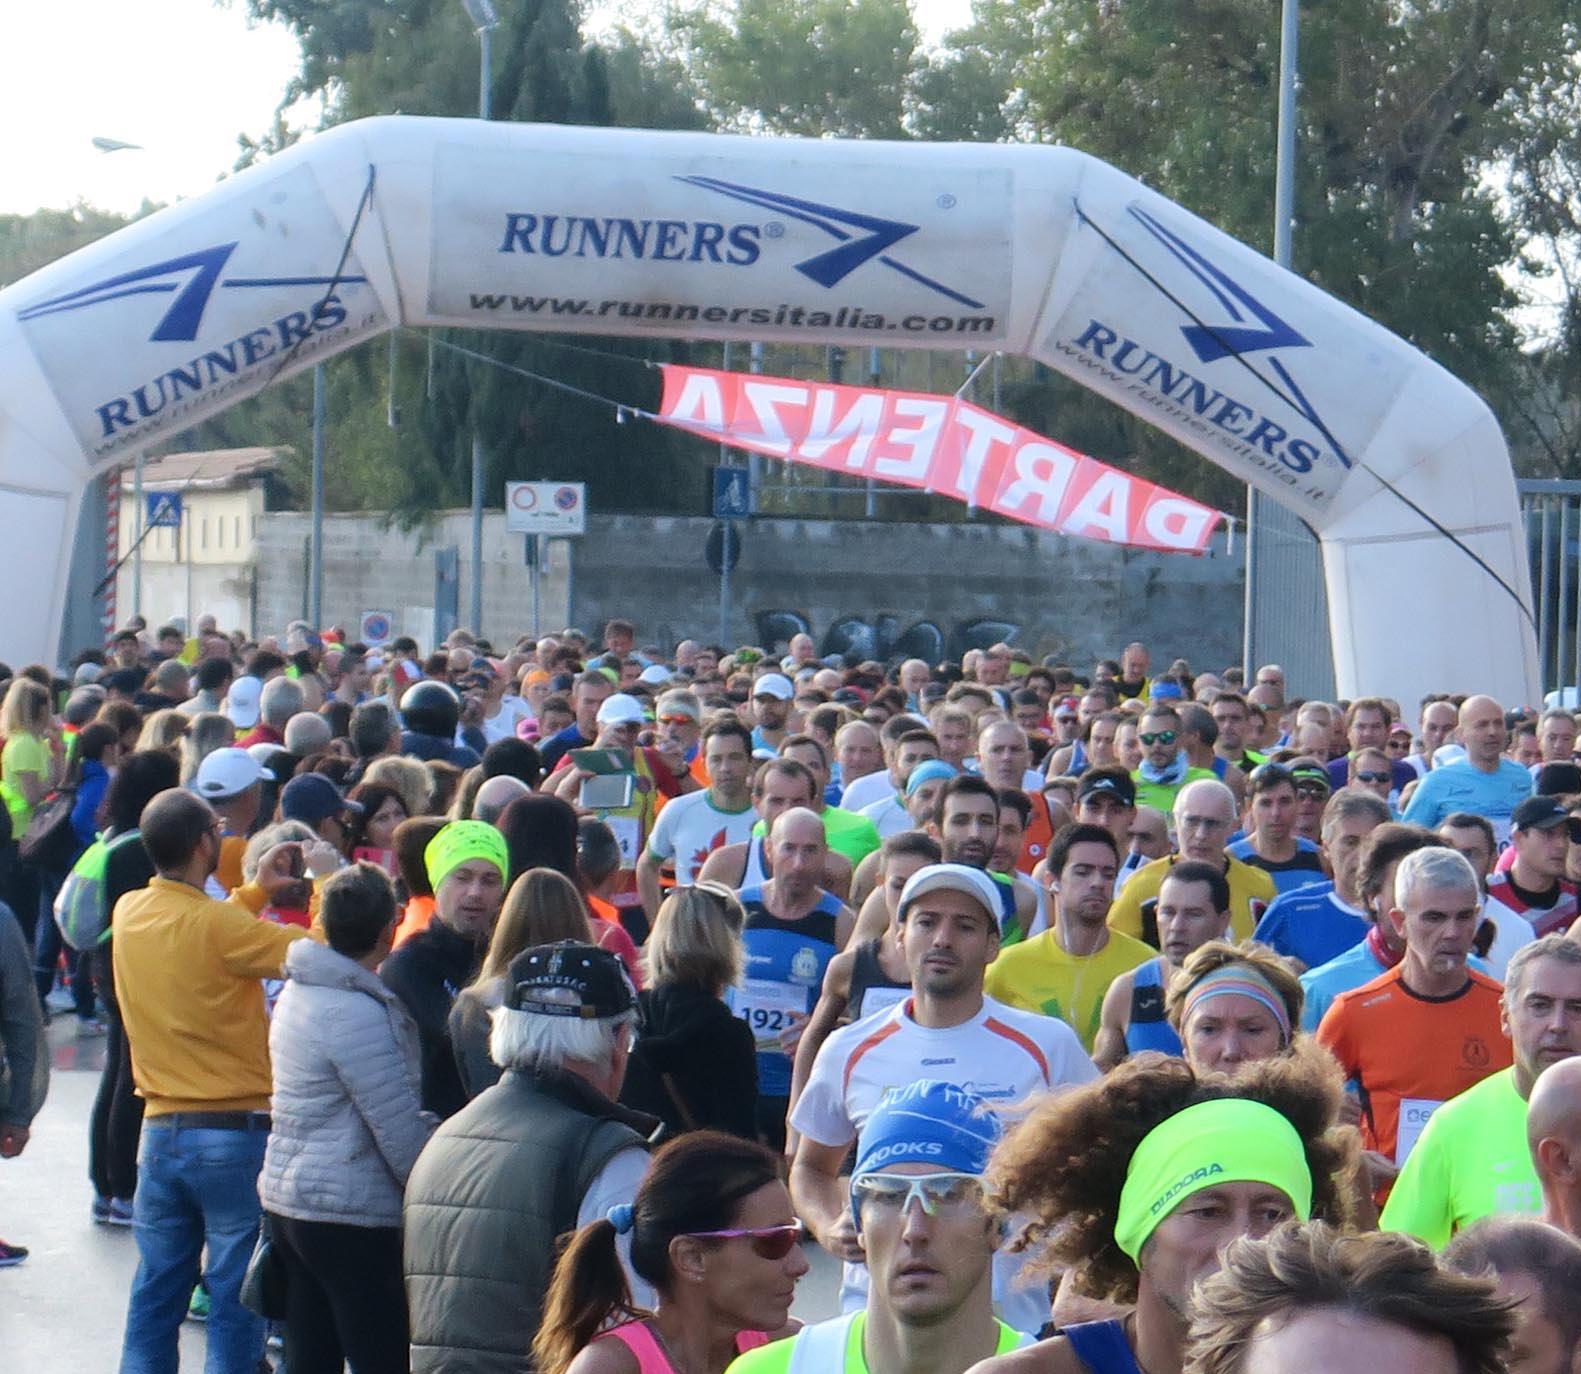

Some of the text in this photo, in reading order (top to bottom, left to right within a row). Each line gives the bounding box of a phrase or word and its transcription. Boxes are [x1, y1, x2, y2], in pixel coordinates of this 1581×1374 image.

[499, 212, 762, 266] RUNNERS
[468, 293, 995, 332] www.runnersitalia.com
[95, 294, 348, 437] RUNNERS
[1074, 319, 1320, 473] RUNNERS
[1150, 1162, 1224, 1217] DIADORA
